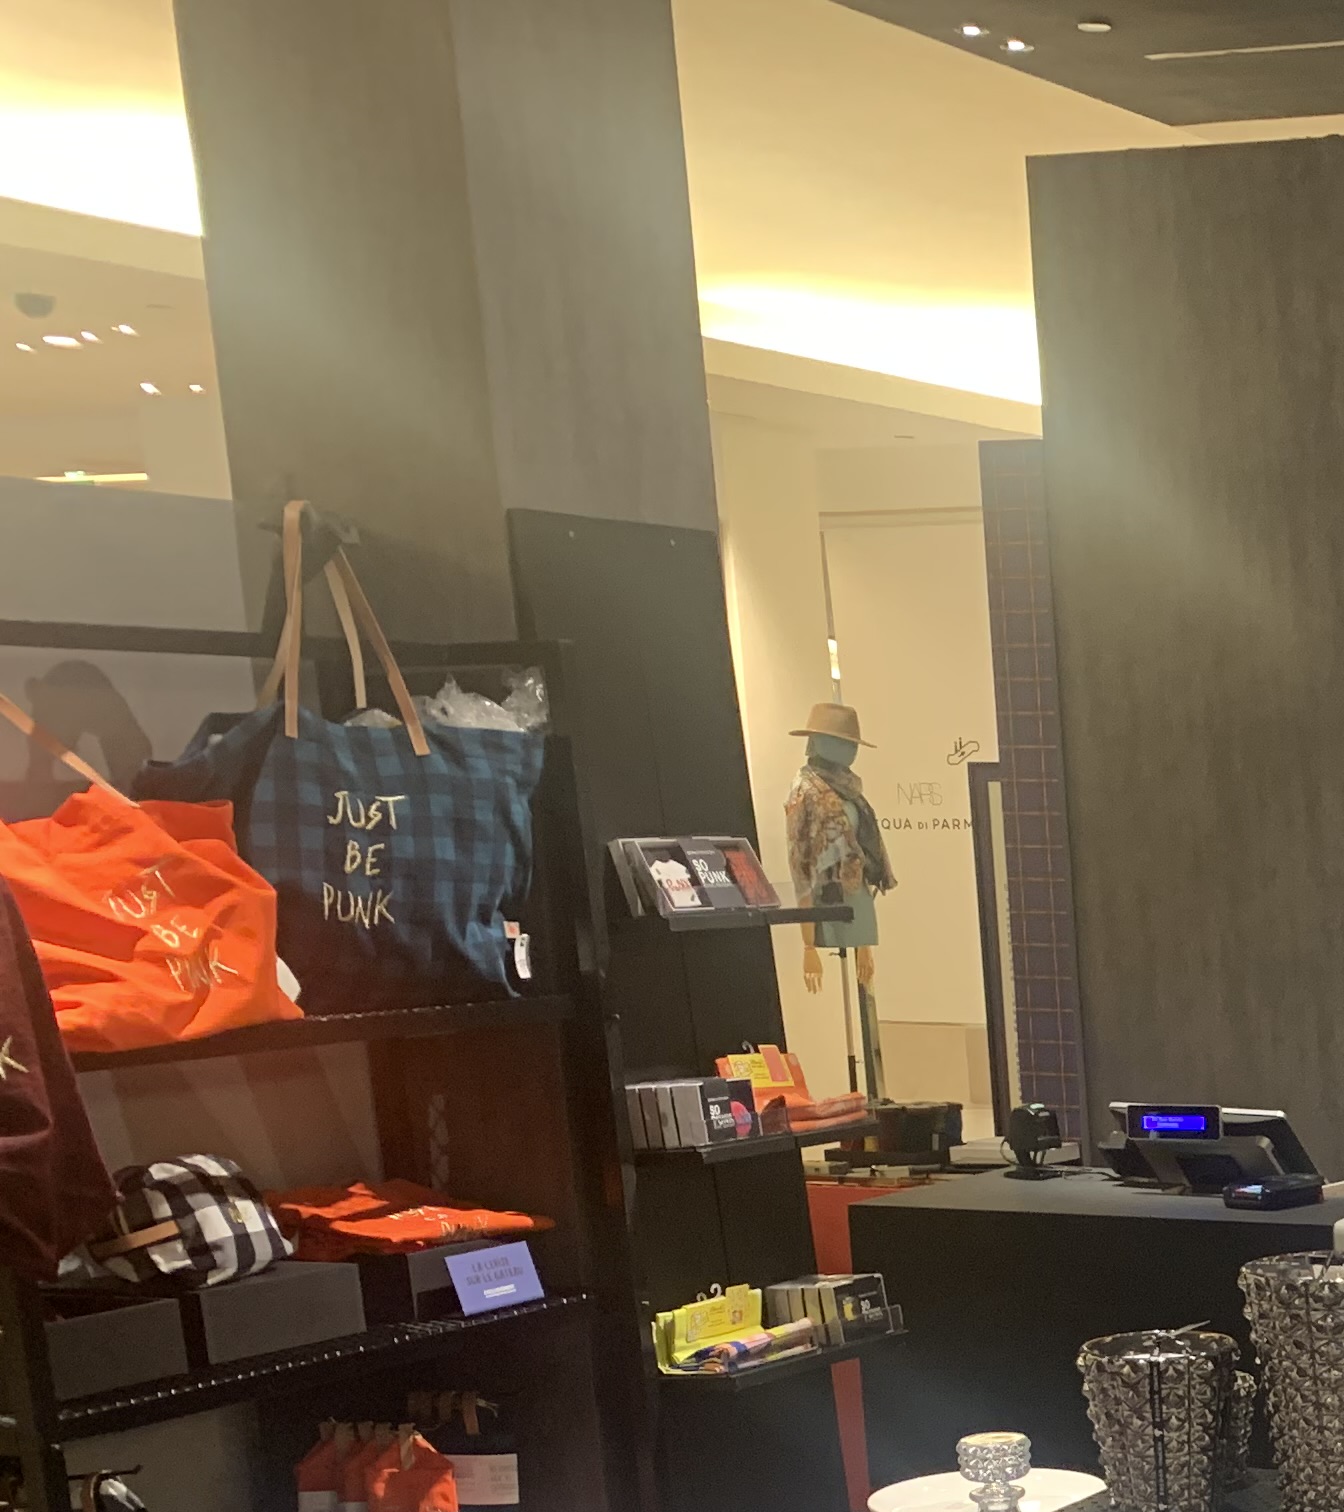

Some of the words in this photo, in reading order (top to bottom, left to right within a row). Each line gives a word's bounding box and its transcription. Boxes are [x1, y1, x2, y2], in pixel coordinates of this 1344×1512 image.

[896, 782, 943, 806] NARS
[326, 790, 408, 831] JUST
[343, 839, 386, 877] BE
[691, 858, 709, 873] SO
[699, 871, 731, 885] PUNK
[321, 881, 396, 930] PUNK
